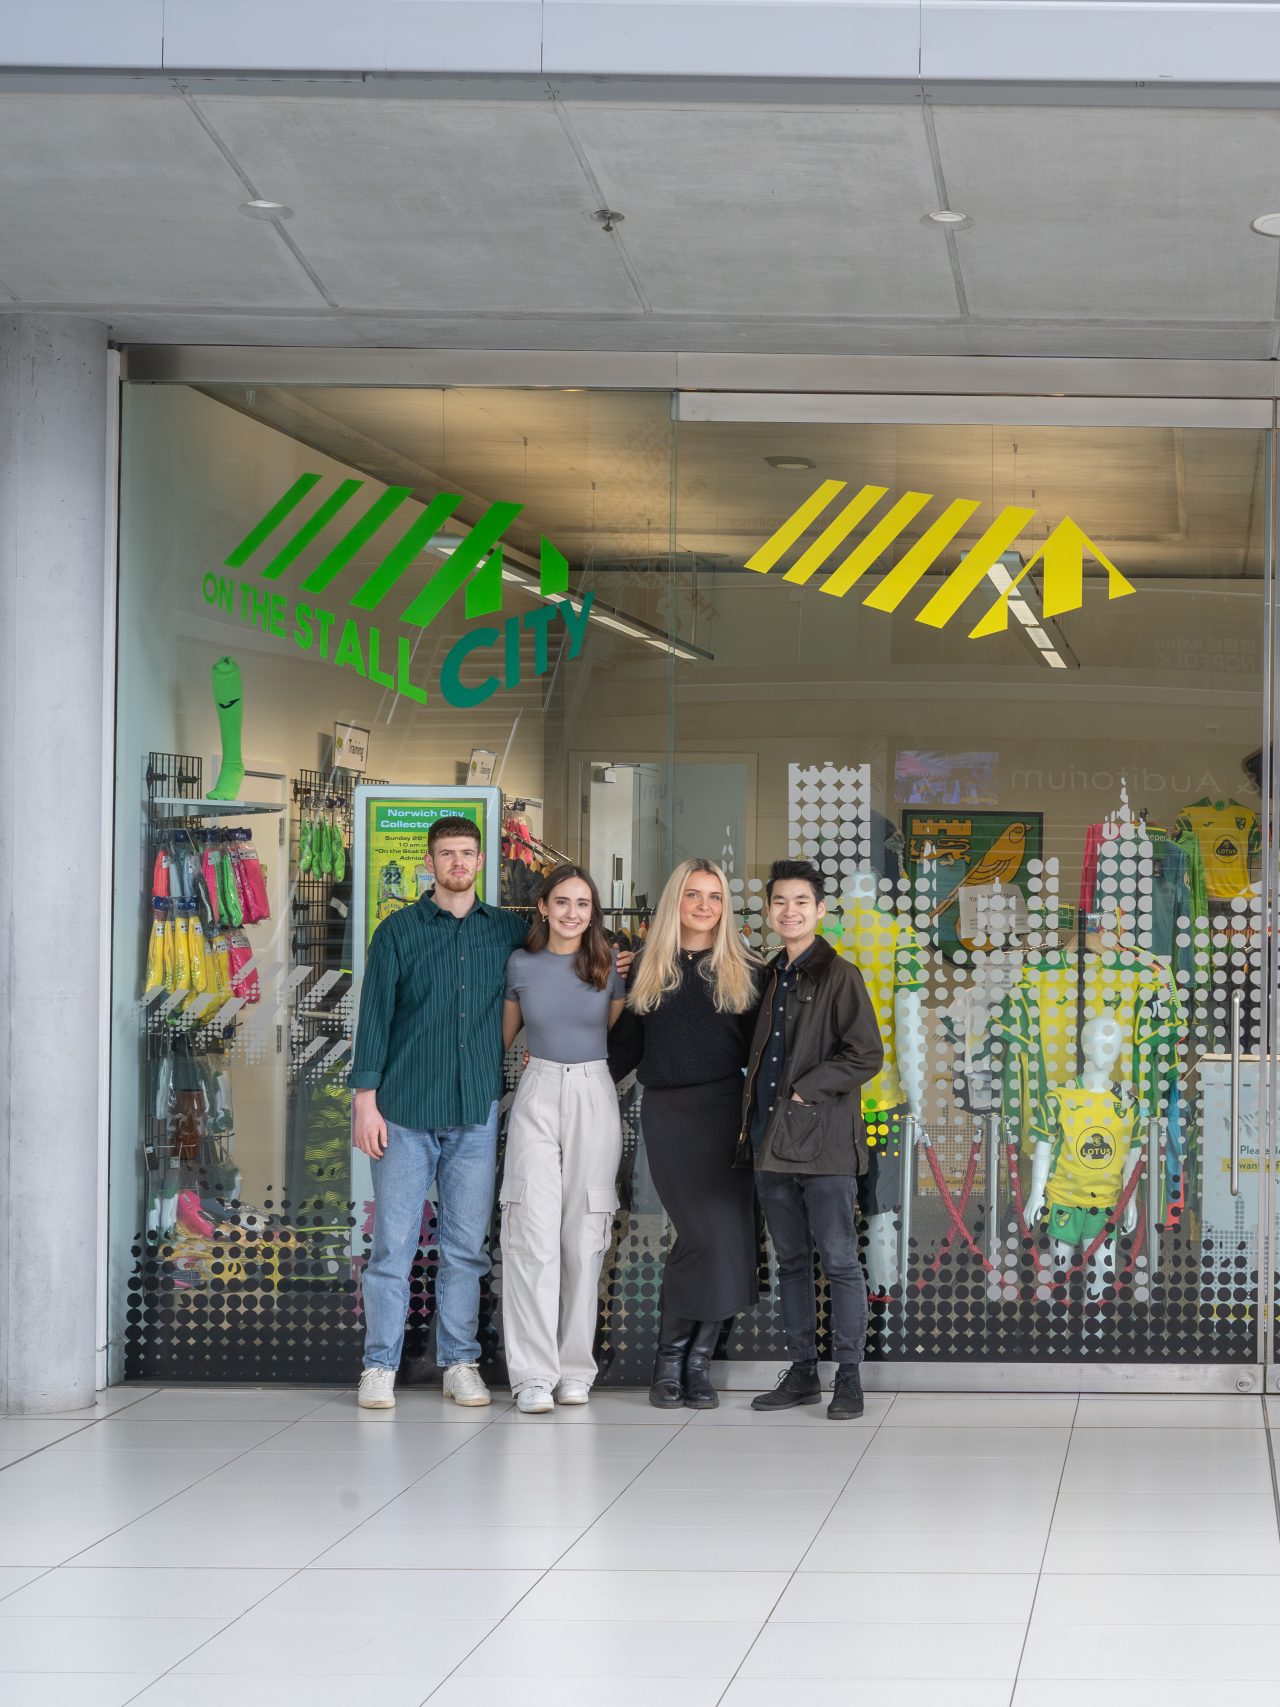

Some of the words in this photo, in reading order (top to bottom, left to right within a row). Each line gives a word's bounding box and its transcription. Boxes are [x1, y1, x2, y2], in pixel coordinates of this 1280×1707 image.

[202, 572, 234, 614] ON
[239, 583, 288, 640] THE
[293, 602, 428, 705] STALL
[440, 591, 596, 709] CITY
[387, 809, 437, 817] Norwich
[440, 809, 465, 818] City
[384, 869, 401, 884] 22
[1082, 1148, 1112, 1156] LOTUS
[1240, 1145, 1270, 1155] Pleae
